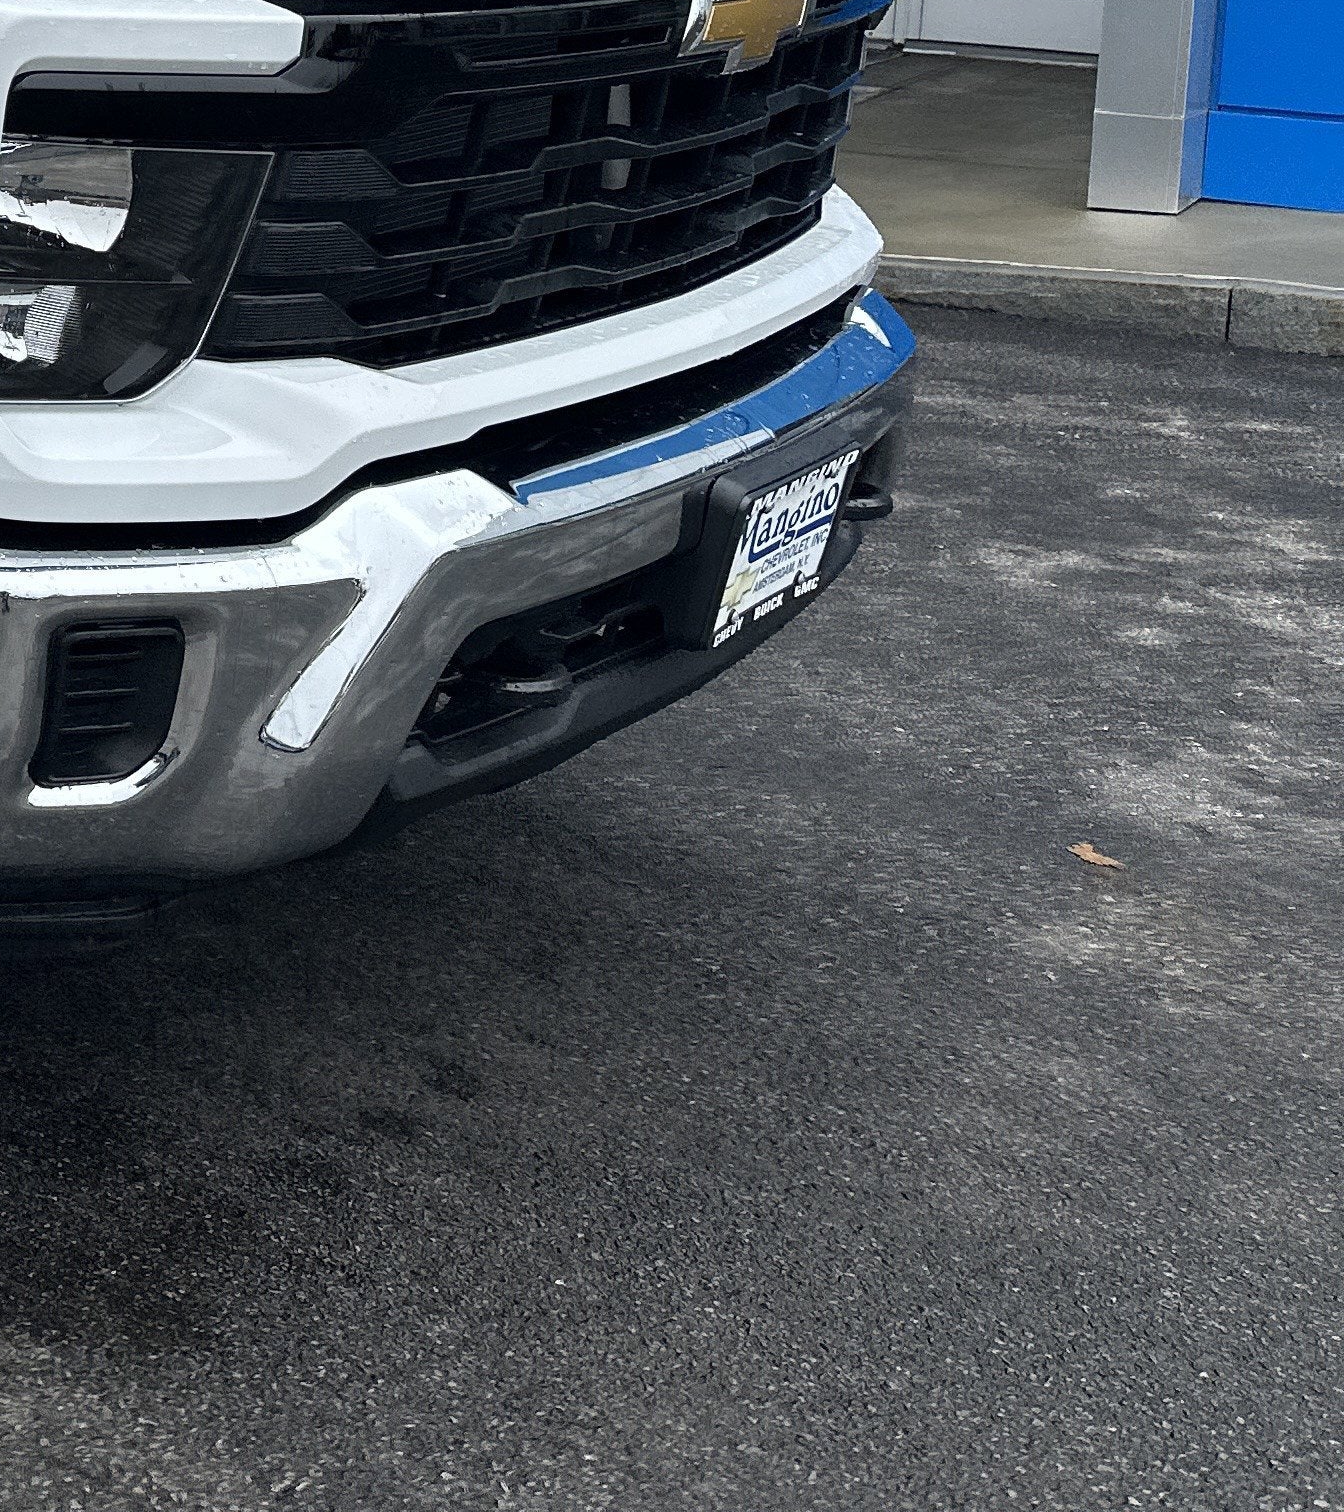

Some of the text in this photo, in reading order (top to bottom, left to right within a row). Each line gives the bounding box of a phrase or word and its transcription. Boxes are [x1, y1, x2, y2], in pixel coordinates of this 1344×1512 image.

[749, 450, 860, 518] MANGINO
[712, 575, 820, 648] CHEVY BUICK GMC
